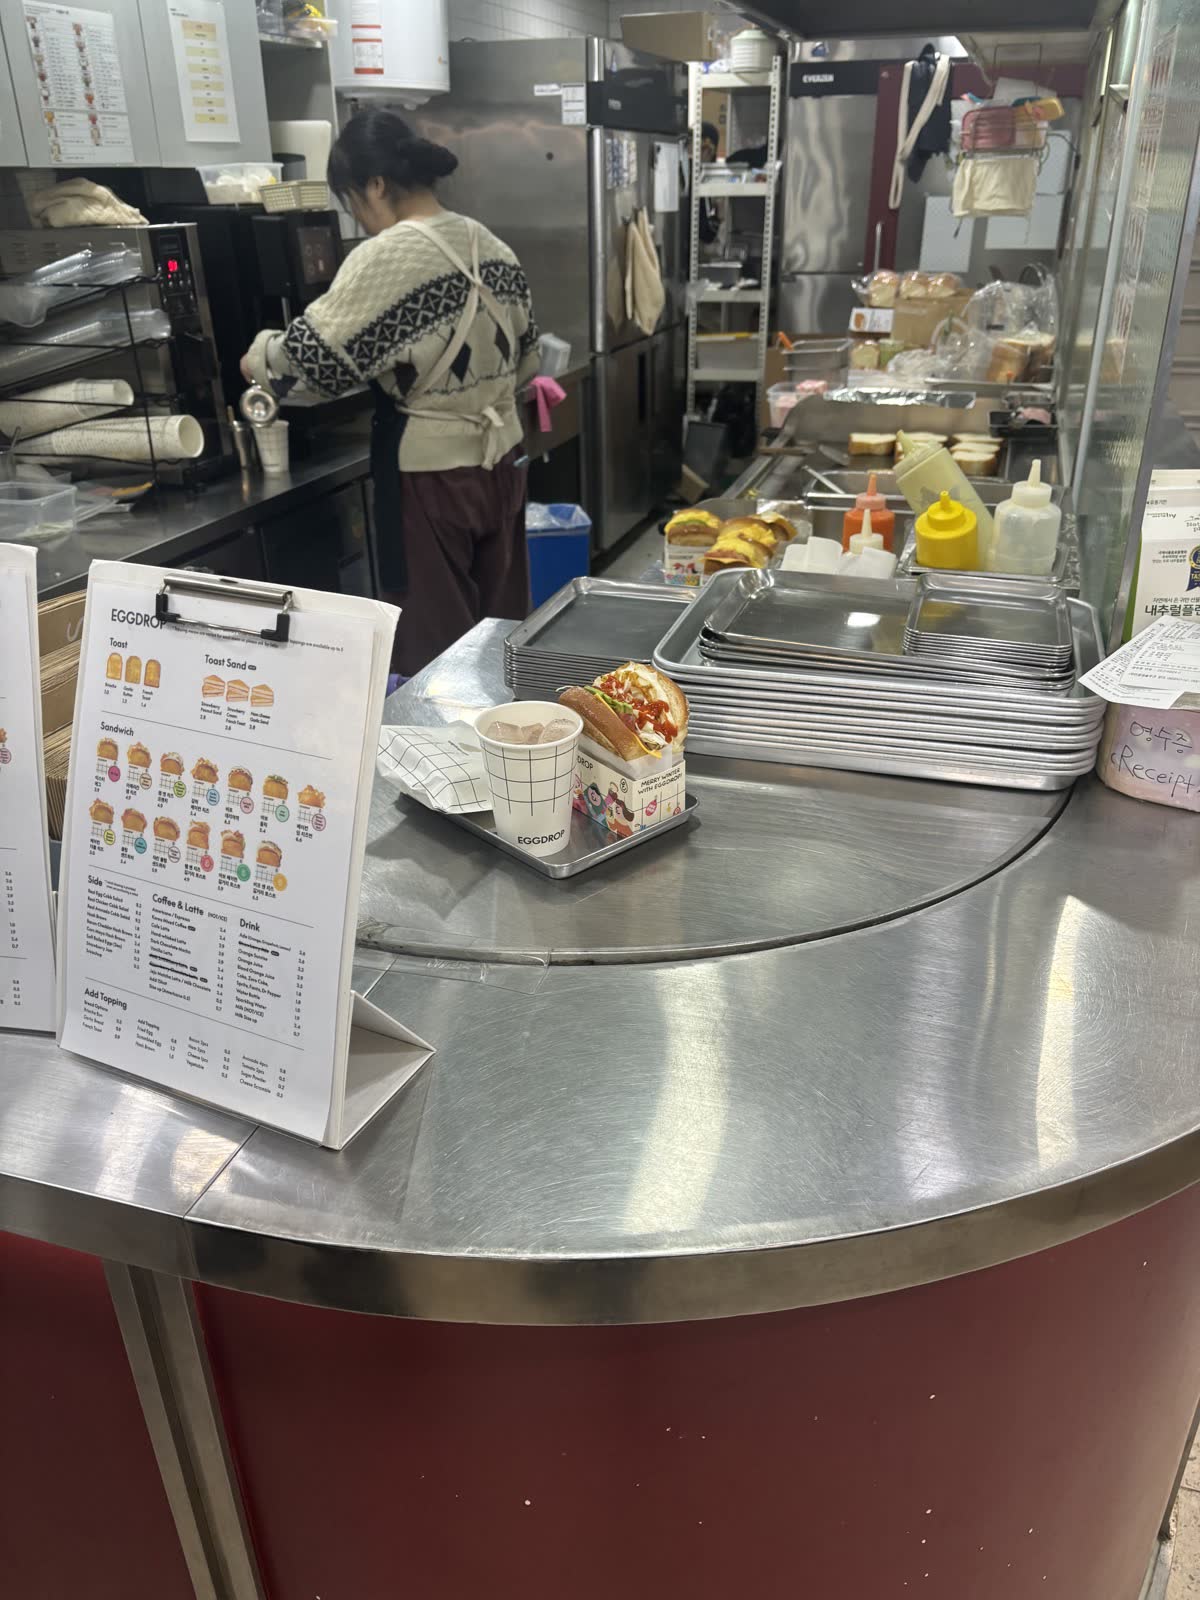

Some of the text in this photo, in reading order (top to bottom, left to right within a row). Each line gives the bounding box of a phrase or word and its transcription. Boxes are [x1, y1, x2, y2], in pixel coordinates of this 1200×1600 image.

[111, 608, 168, 630] EGGDROP
[109, 637, 128, 649] Toast
[205, 654, 247, 670] Toast Sand
[100, 721, 134, 737] Sandwich
[1130, 721, 1193, 754] 영수증
[577, 755, 593, 770] DROP
[1111, 744, 1200, 797] (Receipt
[640, 767, 681, 787] MERRY WINTER
[637, 785, 653, 795] WITH
[517, 829, 565, 845] EGGDROP
[88, 875, 103, 887] Side
[153, 893, 176, 908] Coffee
[178, 900, 183, 910] &
[185, 902, 204, 916] Latte
[240, 918, 260, 932] Drink
[85, 987, 127, 1011] Add Topping
